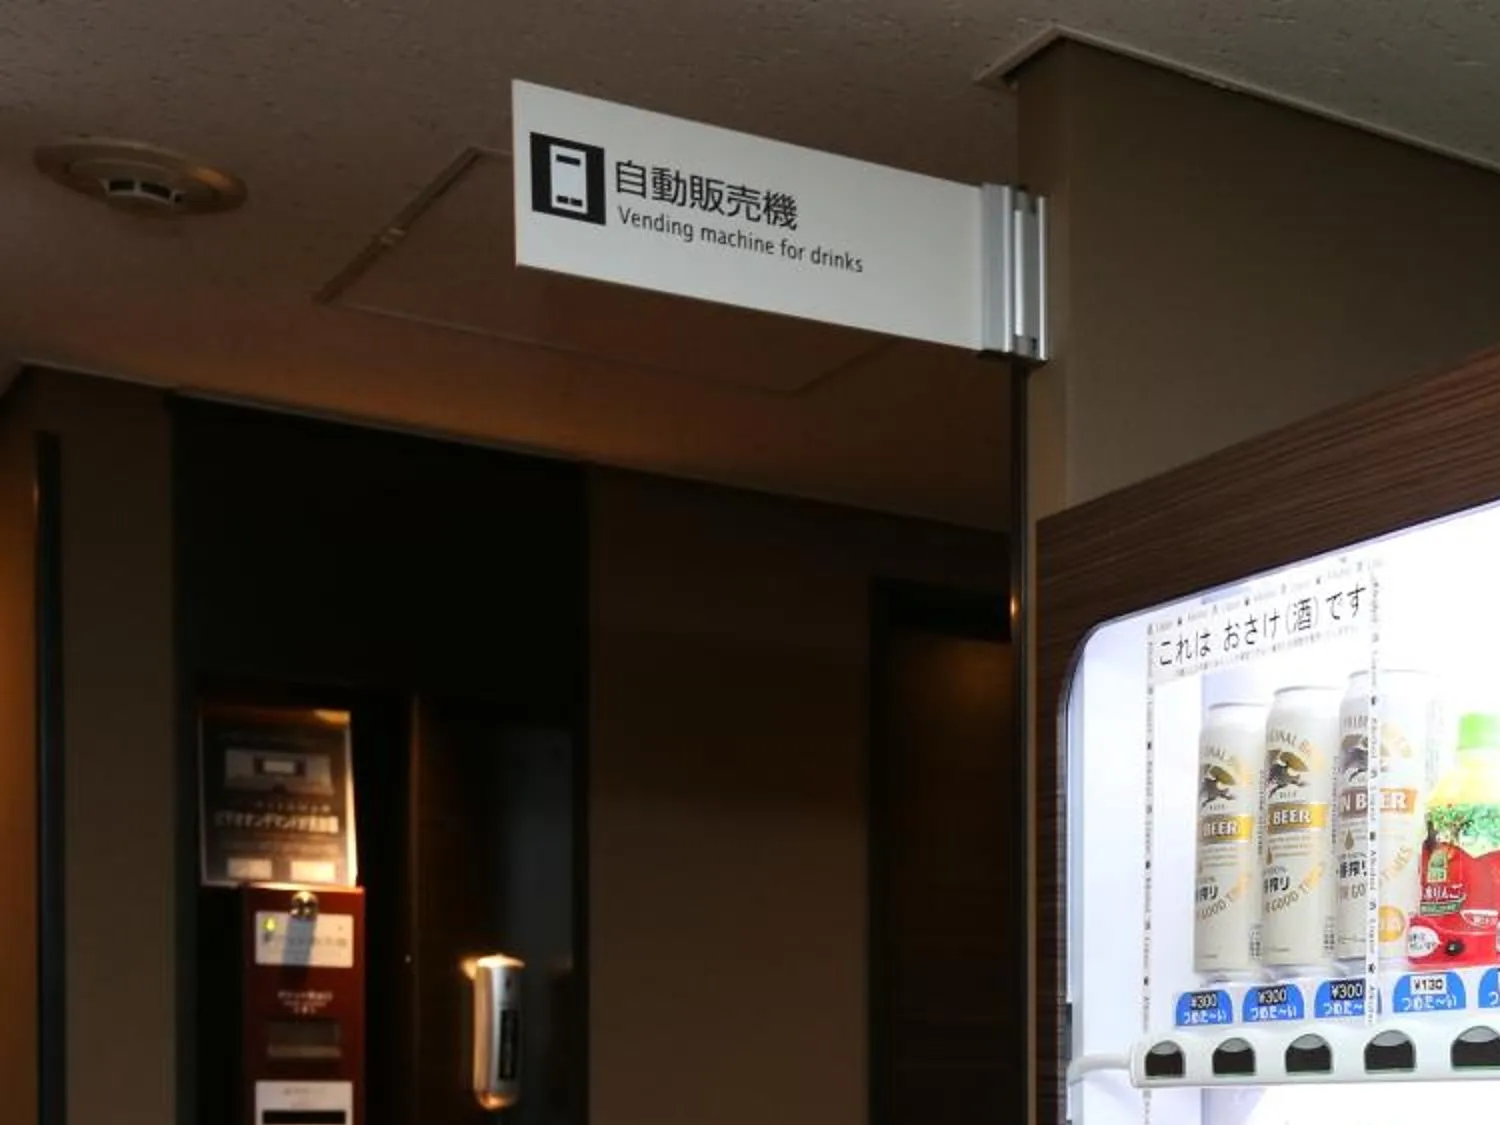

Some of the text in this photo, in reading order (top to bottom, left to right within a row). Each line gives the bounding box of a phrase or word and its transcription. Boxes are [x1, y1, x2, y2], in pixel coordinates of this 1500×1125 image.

[615, 159, 799, 231] 自動販売機
[618, 206, 864, 273] Vending machine for drinks
[1355, 790, 1407, 809] BER
[1273, 809, 1312, 825] BEER
[1329, 981, 1363, 1000] ¥300
[1414, 977, 1444, 993] ¥130
